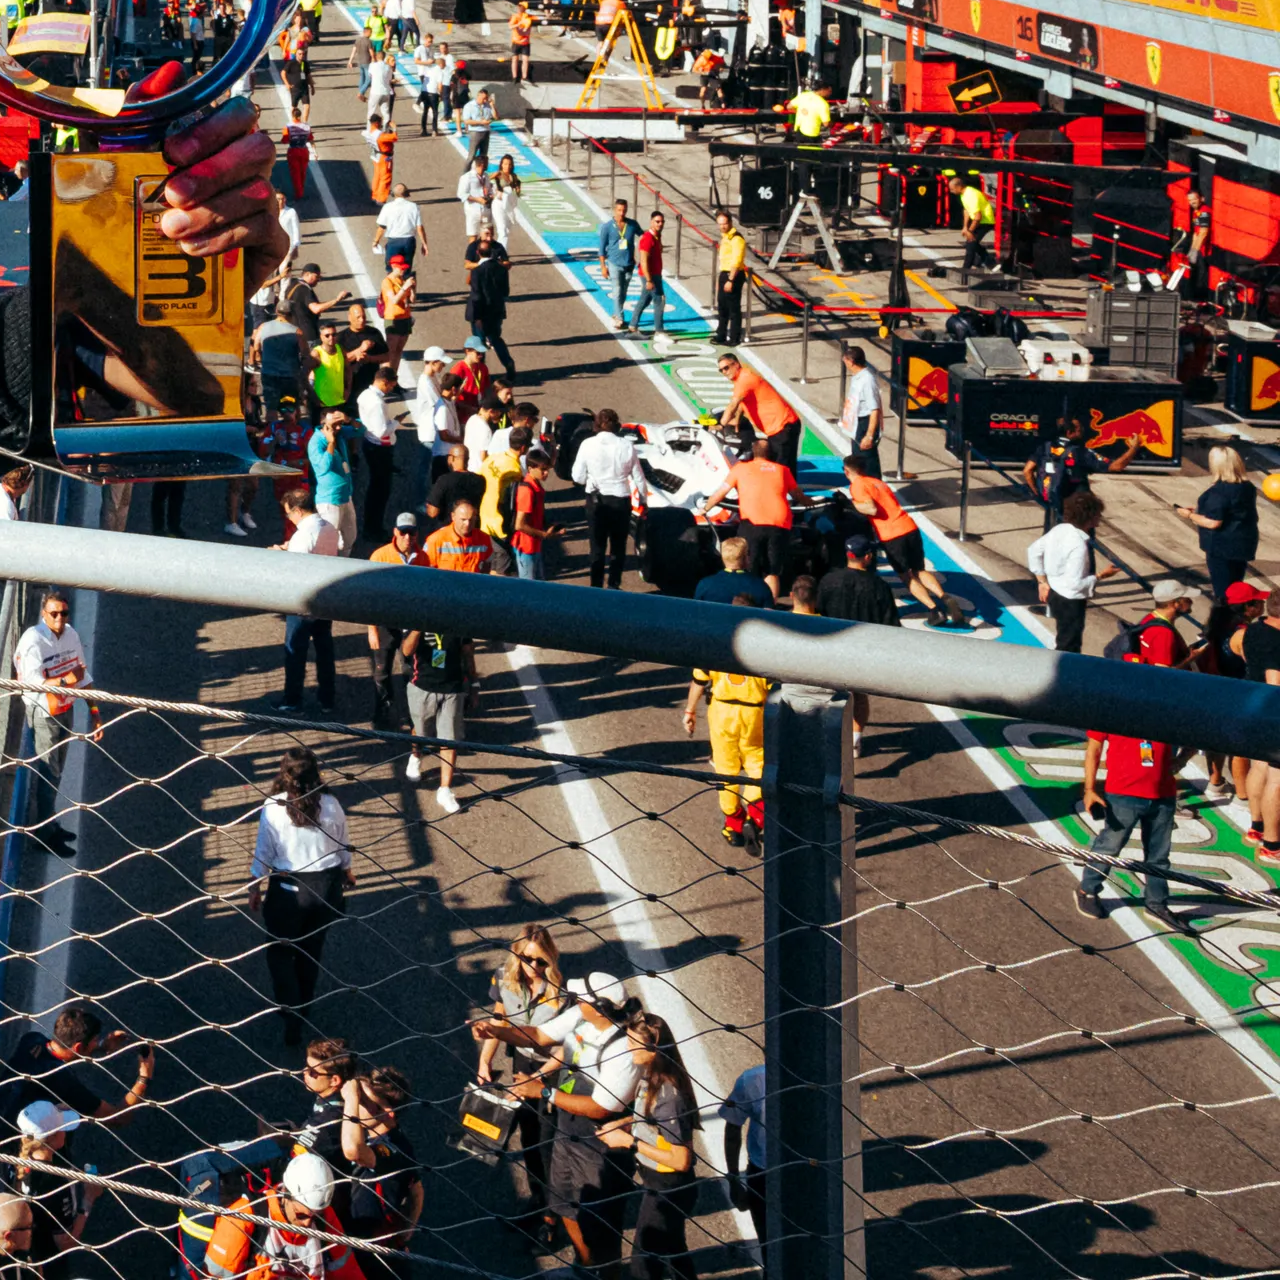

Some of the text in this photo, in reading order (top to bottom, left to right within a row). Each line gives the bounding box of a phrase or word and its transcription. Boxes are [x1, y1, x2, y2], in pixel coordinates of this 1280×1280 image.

[1016, 16, 1034, 43] 16
[1040, 31, 1073, 54] LECLERC
[757, 184, 774, 202] 16
[143, 253, 207, 301] 3
[171, 302, 199, 310] PLACE
[989, 413, 1040, 422] ORACLE
